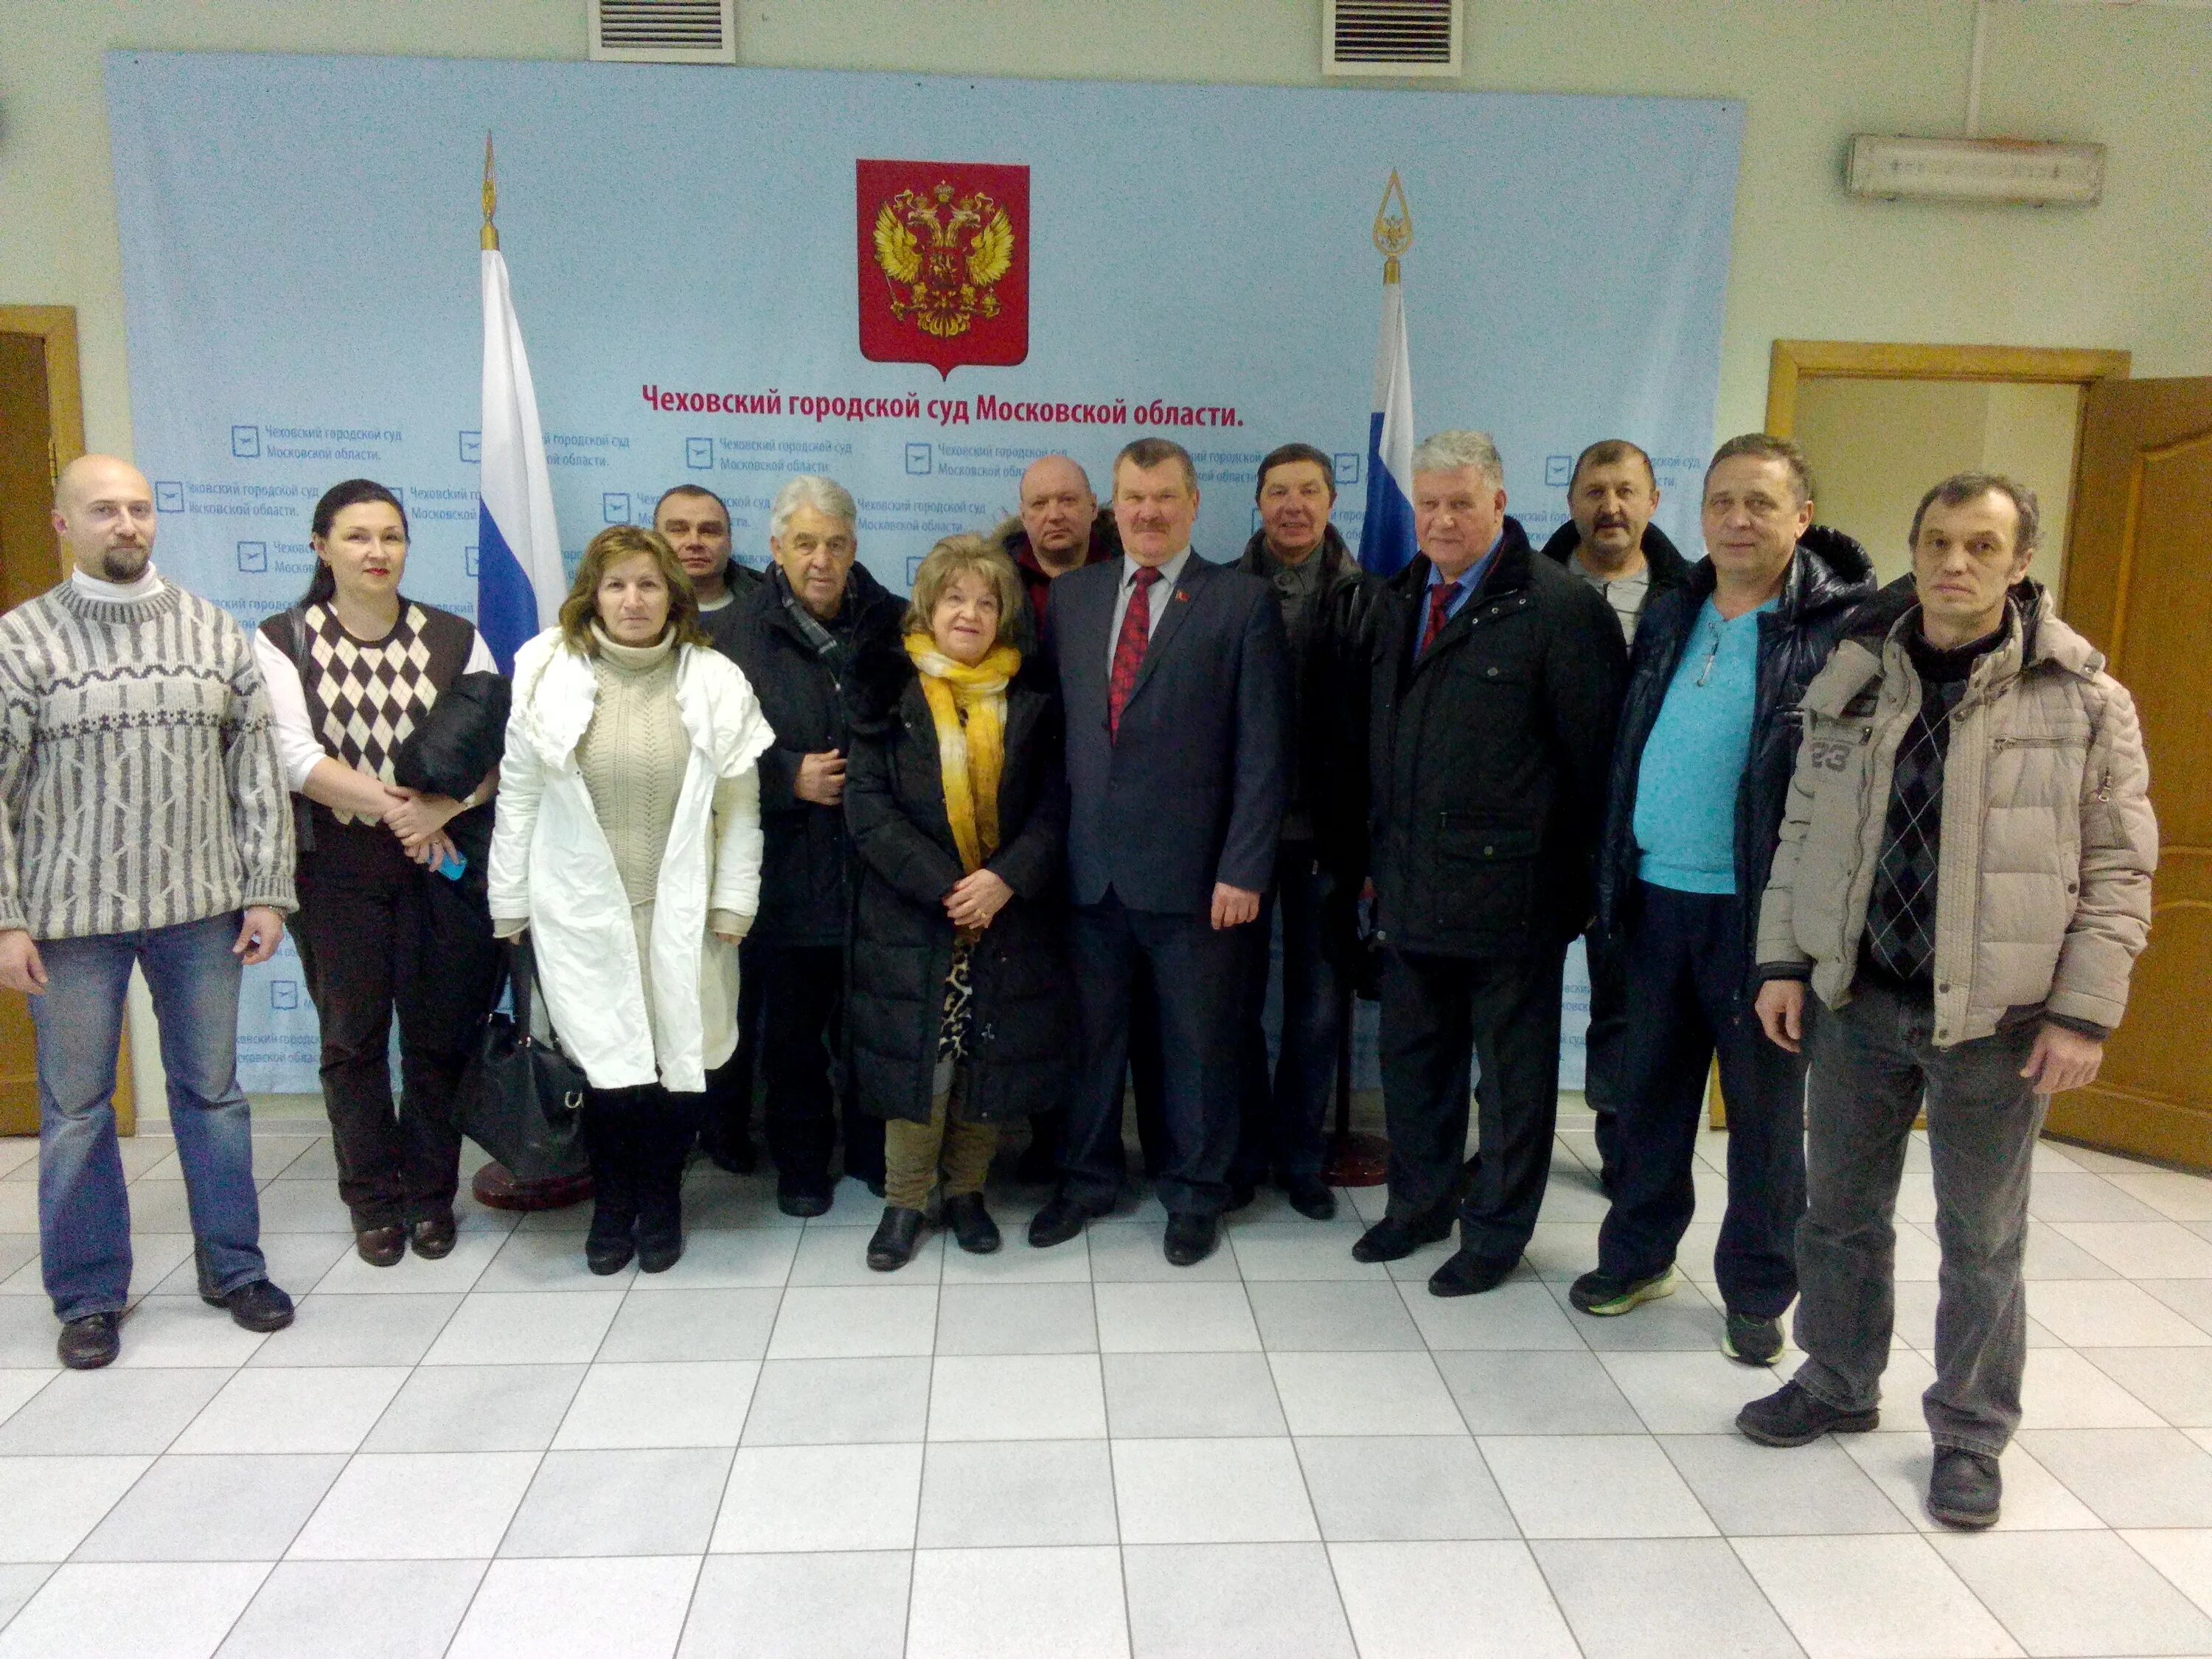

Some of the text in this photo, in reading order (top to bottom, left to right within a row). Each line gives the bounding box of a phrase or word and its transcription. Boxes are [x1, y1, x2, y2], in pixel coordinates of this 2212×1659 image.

[642, 384, 1244, 427] Чеховский городской суд Московской области.
[265, 425, 403, 442] Чеховский городской суд
[553, 432, 608, 448] городской
[611, 437, 630, 448] суд
[266, 445, 332, 460] Московской
[720, 437, 852, 455] Чеховский городской суд
[938, 443, 992, 457] Чеховский
[995, 445, 1048, 459] городской
[720, 457, 785, 472] Московской
[938, 462, 1000, 477] Московской
[1682, 458, 1701, 470] суд
[243, 484, 299, 498] городской
[301, 487, 319, 499] суд
[410, 487, 467, 501] Чеховский
[412, 507, 478, 520] Московской
[858, 498, 986, 515] Чеховский городской суд
[858, 518, 919, 532] Московской
